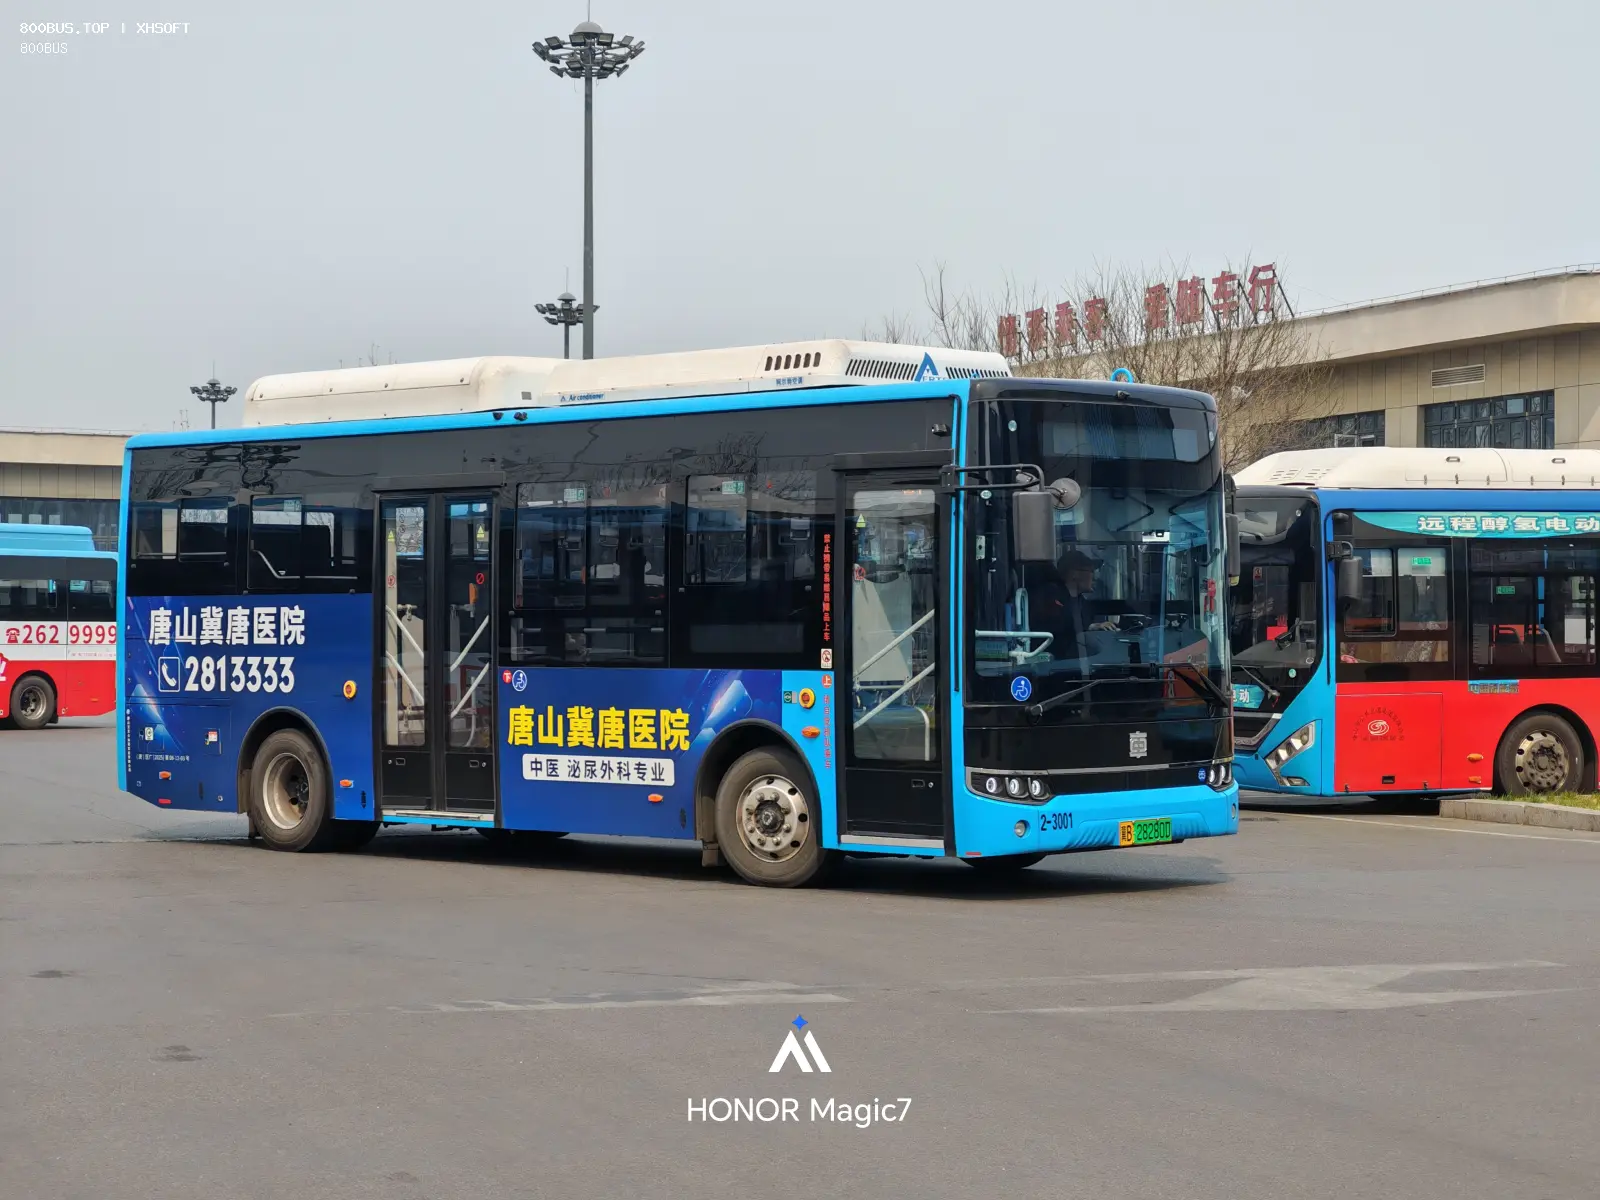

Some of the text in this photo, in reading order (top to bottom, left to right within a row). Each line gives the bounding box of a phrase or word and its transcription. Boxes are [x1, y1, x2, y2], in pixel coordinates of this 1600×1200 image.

[1417, 516, 1600, 532] 远程醇氢电动
[148, 605, 306, 648] 唐山冀唐医院
[184, 656, 296, 694] 2813333
[507, 704, 691, 752] 唐山冀唐医院
[530, 757, 665, 782] 中医 泌尿外科专业
[1040, 812, 1074, 832] 2-3001
